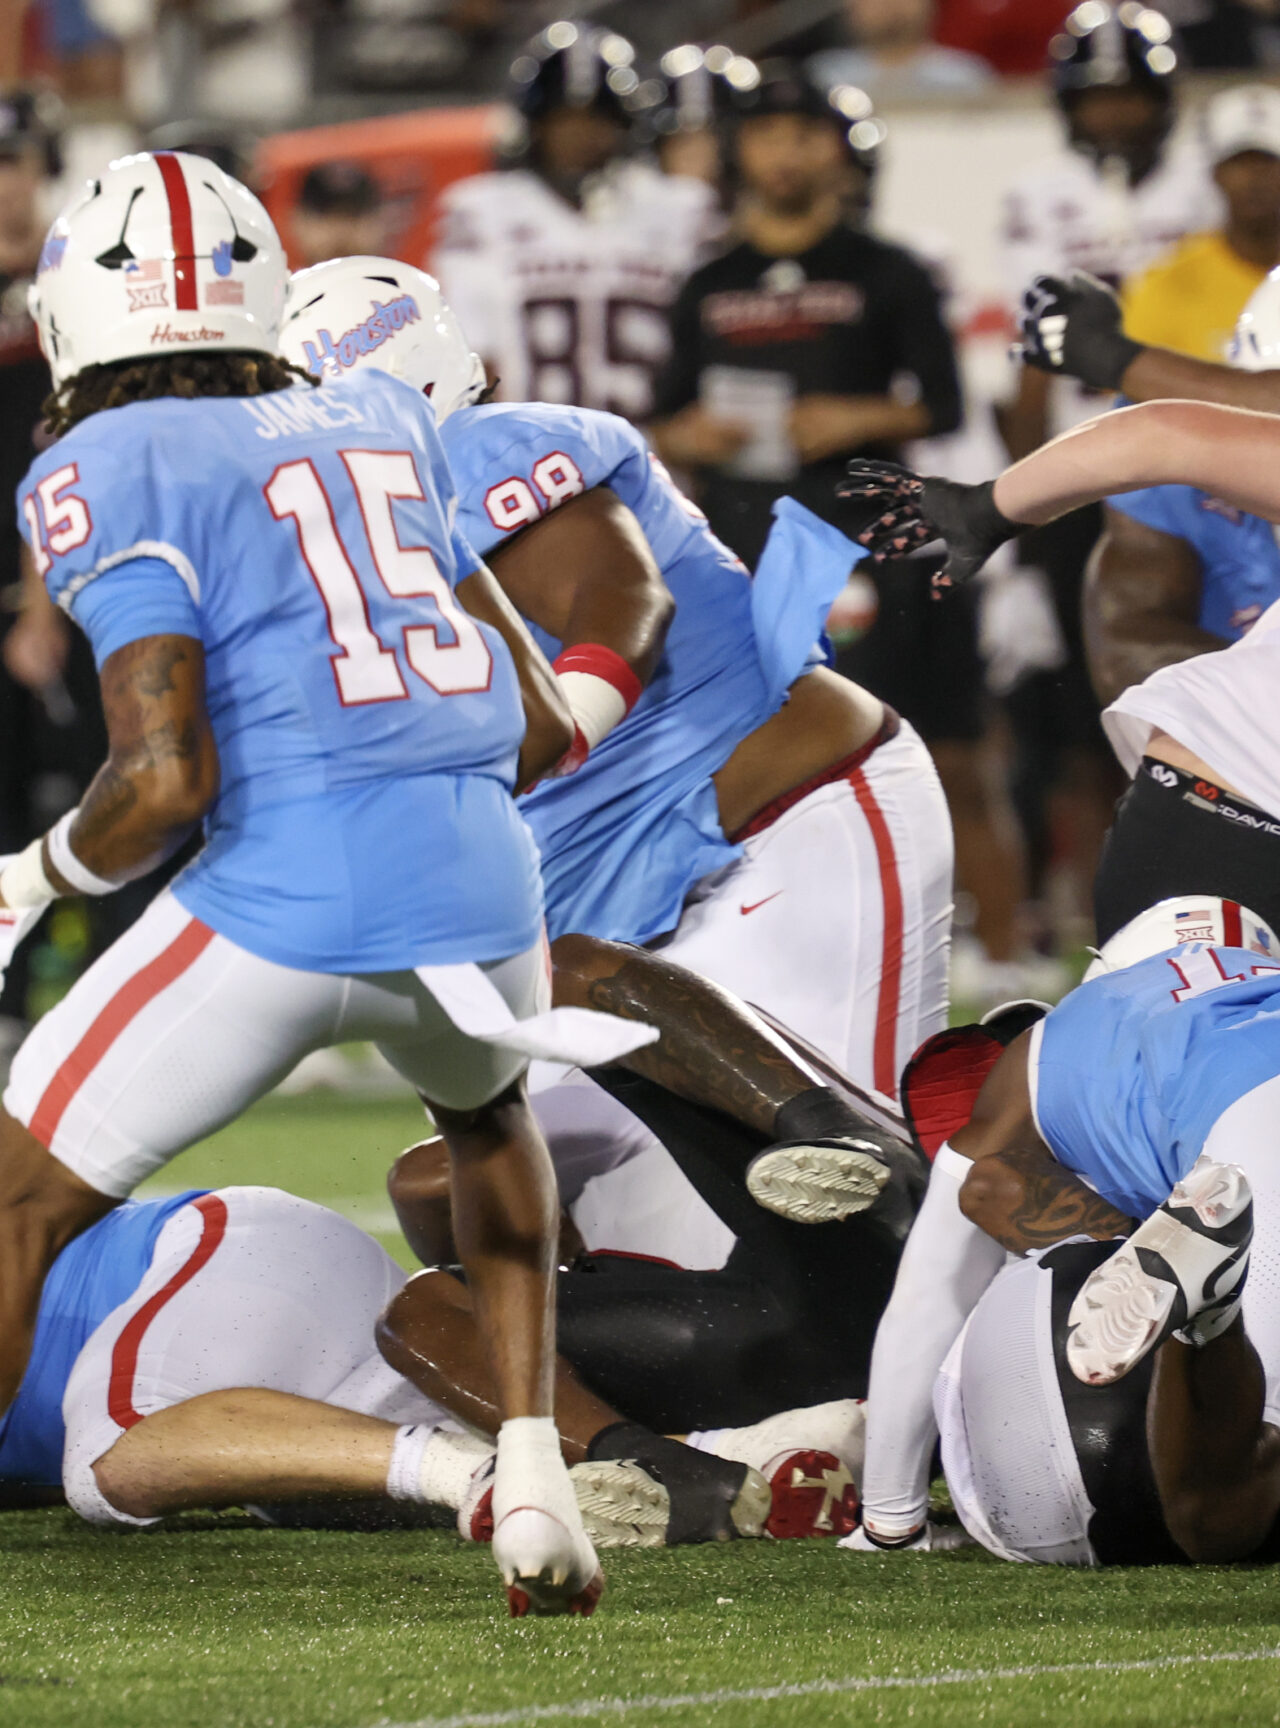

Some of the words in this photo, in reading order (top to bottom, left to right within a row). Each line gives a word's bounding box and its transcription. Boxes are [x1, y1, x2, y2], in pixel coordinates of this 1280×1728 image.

[151, 324, 225, 345] Houston
[302, 294, 421, 376] Houston
[523, 298, 670, 424] 85
[240, 388, 364, 441] JAMES
[23, 461, 94, 582] 15
[483, 450, 585, 532] 98
[262, 448, 494, 707] 15
